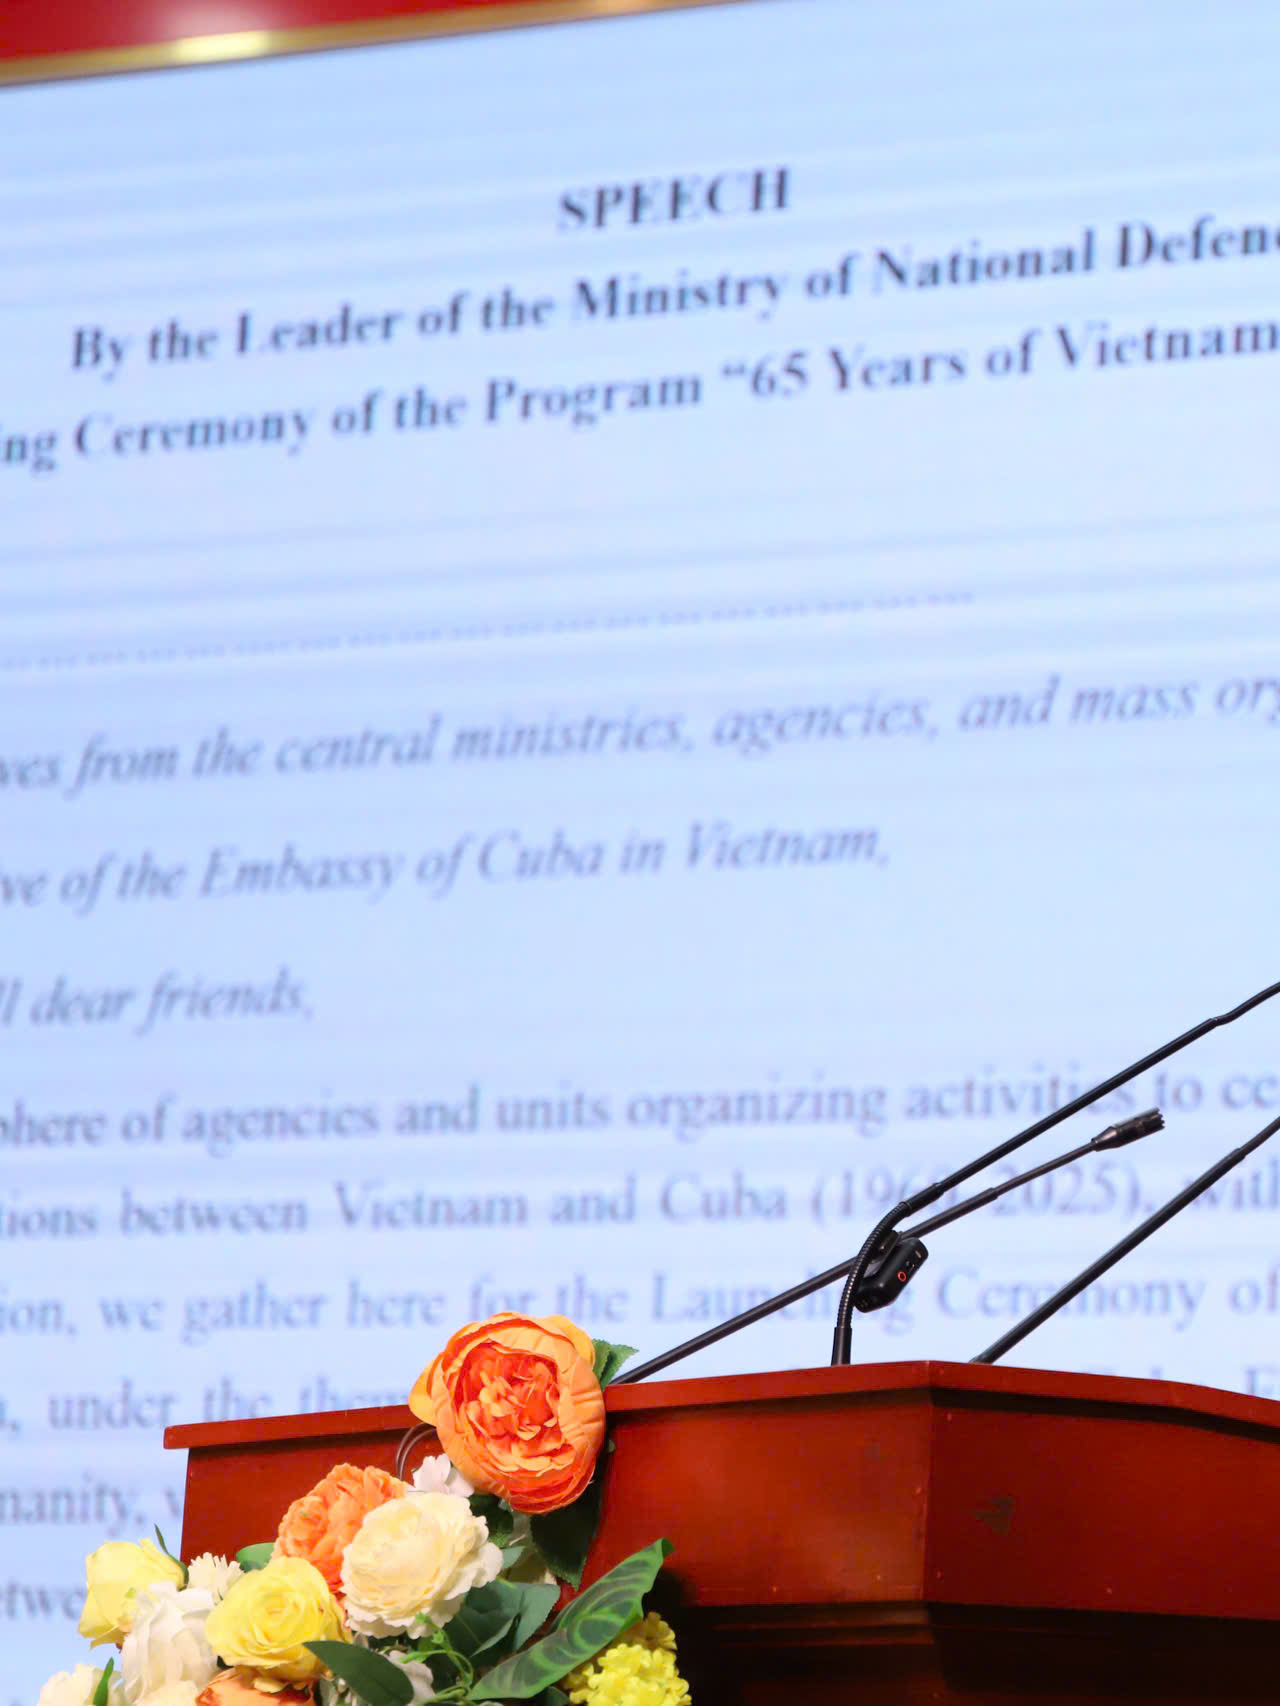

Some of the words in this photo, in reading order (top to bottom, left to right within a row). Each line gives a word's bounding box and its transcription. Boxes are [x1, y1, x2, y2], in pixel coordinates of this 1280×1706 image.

[558, 166, 790, 231] SPEECH
[73, 325, 127, 380] By
[149, 318, 218, 362] the
[236, 302, 403, 354] Leader
[418, 289, 470, 335] of
[481, 286, 555, 330] the
[571, 269, 787, 321] Ministry
[805, 251, 861, 300] of
[872, 227, 1096, 291] National
[0, 428, 57, 475] ng
[75, 404, 309, 456] Ceremony
[332, 391, 381, 435] of
[394, 387, 466, 430] the
[485, 376, 702, 428] Program
[828, 343, 968, 393] Years
[985, 325, 1042, 377] of
[66, 730, 180, 800] from
[191, 724, 264, 778] the
[274, 711, 441, 775] central
[451, 705, 694, 762] ministries,
[712, 690, 941, 758] agencies,
[958, 672, 1061, 732] and
[1069, 680, 1198, 725] mass
[59, 850, 116, 918] of
[116, 848, 184, 900] the
[200, 840, 405, 905] Embassy
[415, 826, 476, 901] of
[478, 822, 602, 883] Cuba
[617, 824, 668, 876] in
[683, 817, 890, 872] Vietnam,
[30, 975, 135, 1028] dear
[131, 963, 314, 1036] friends,
[120, 1094, 177, 1146] of
[181, 1088, 380, 1160] agencies
[398, 1082, 480, 1136] and
[496, 1078, 610, 1132] units
[626, 1067, 888, 1143] organizing
[902, 1058, 1135, 1122] activities
[1154, 1068, 1202, 1112] to
[0, 1192, 98, 1241] ions
[120, 1189, 309, 1236] between
[335, 1182, 528, 1229] Vietnam
[548, 1172, 637, 1224] and
[659, 1168, 787, 1224] Cuba
[100, 1294, 165, 1330] we
[182, 1276, 326, 1346] gather
[347, 1276, 445, 1328] here
[469, 1272, 535, 1326] for
[555, 1272, 629, 1324] the
[938, 1260, 1207, 1332] Ceremony
[48, 1378, 180, 1432] under
